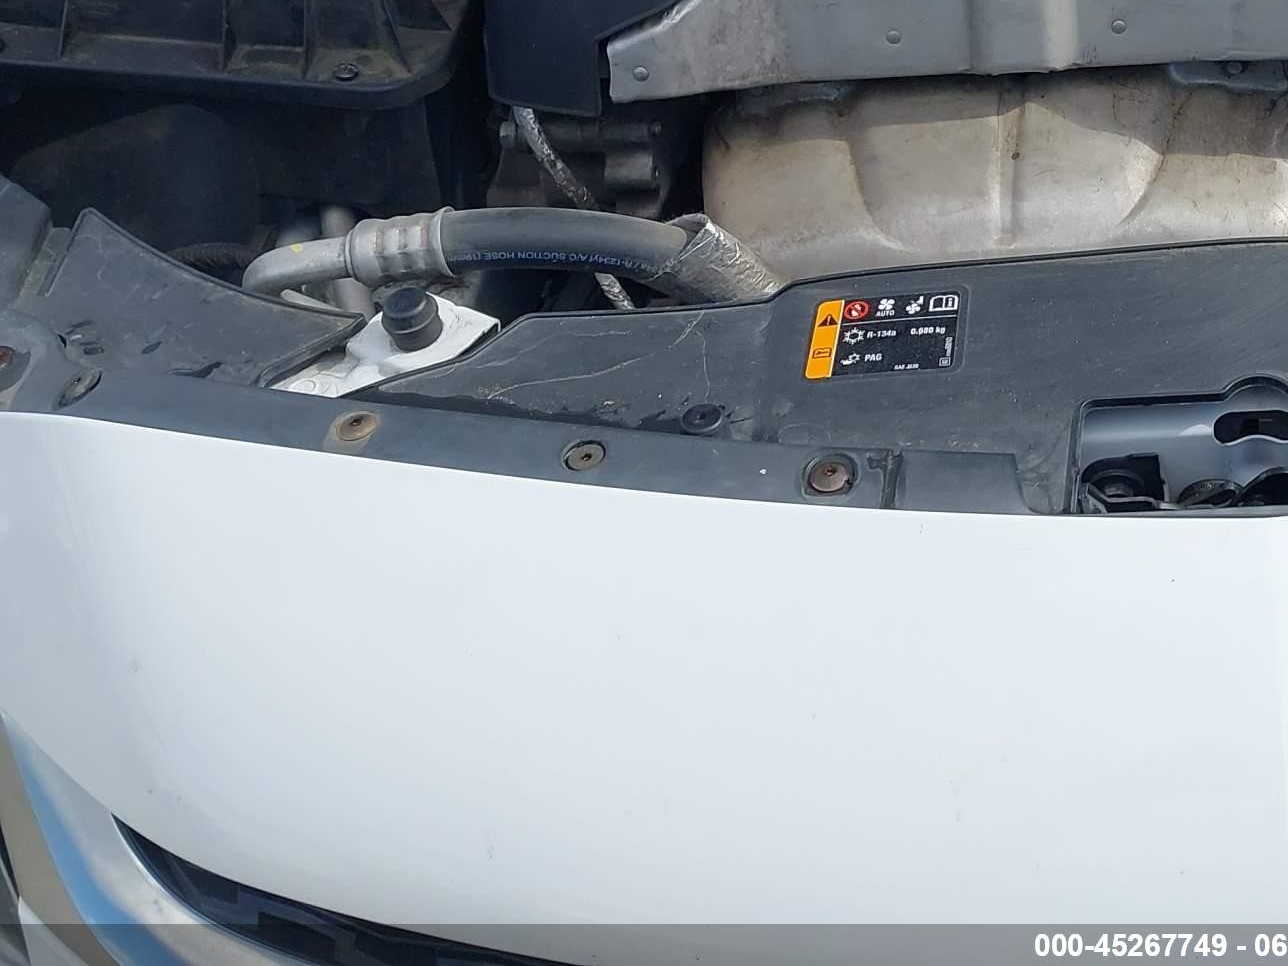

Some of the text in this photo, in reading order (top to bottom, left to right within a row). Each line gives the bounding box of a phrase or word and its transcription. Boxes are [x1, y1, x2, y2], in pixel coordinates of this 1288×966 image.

[485, 250, 515, 261] HOSE
[517, 251, 567, 262] SUCTION
[867, 330, 896, 339] R-134a
[935, 326, 946, 334] kg
[864, 353, 882, 362] PAG
